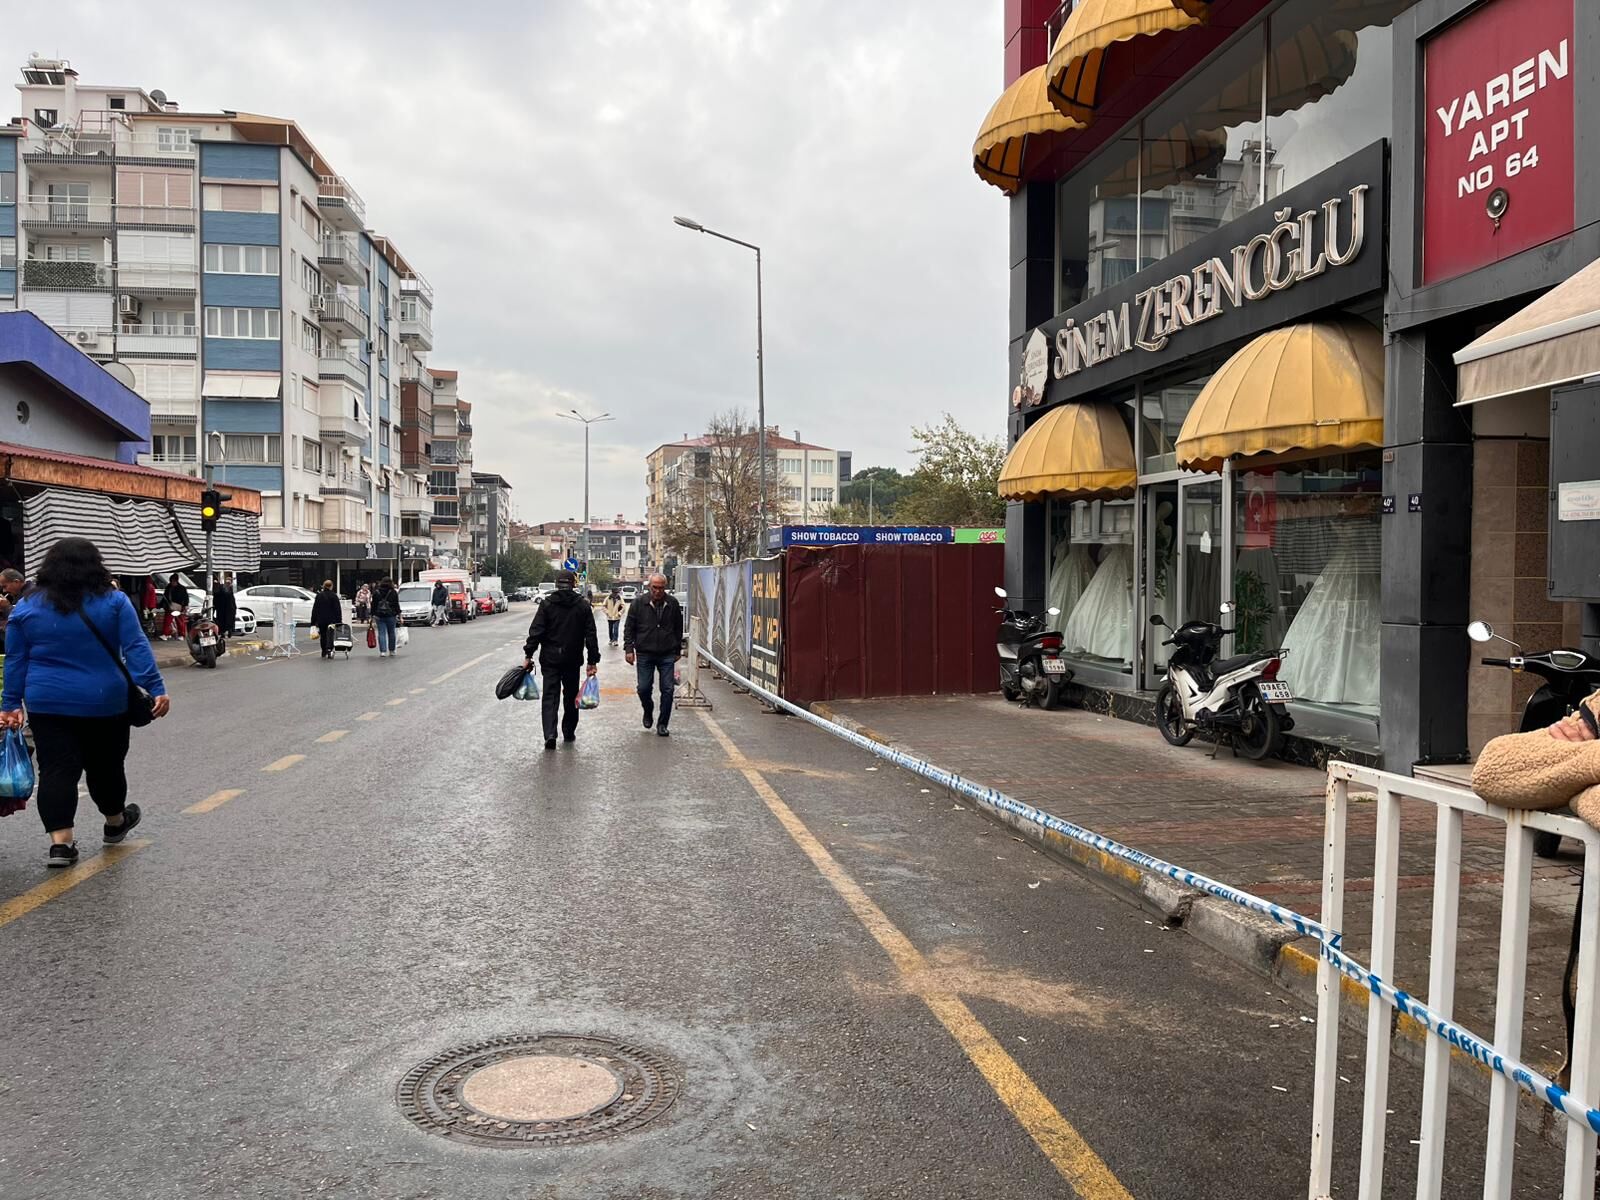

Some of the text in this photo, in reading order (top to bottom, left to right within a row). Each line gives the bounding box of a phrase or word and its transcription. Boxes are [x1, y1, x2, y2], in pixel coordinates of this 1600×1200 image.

[1436, 39, 1568, 137] YAREN
[1468, 108, 1529, 162] APT
[1458, 145, 1539, 198] NO 64
[1053, 184, 1369, 380] SİNEM ZERENOĞLU
[791, 532, 859, 541] SHOW TOBACCO
[875, 532, 943, 541] SHOW TOBACCO
